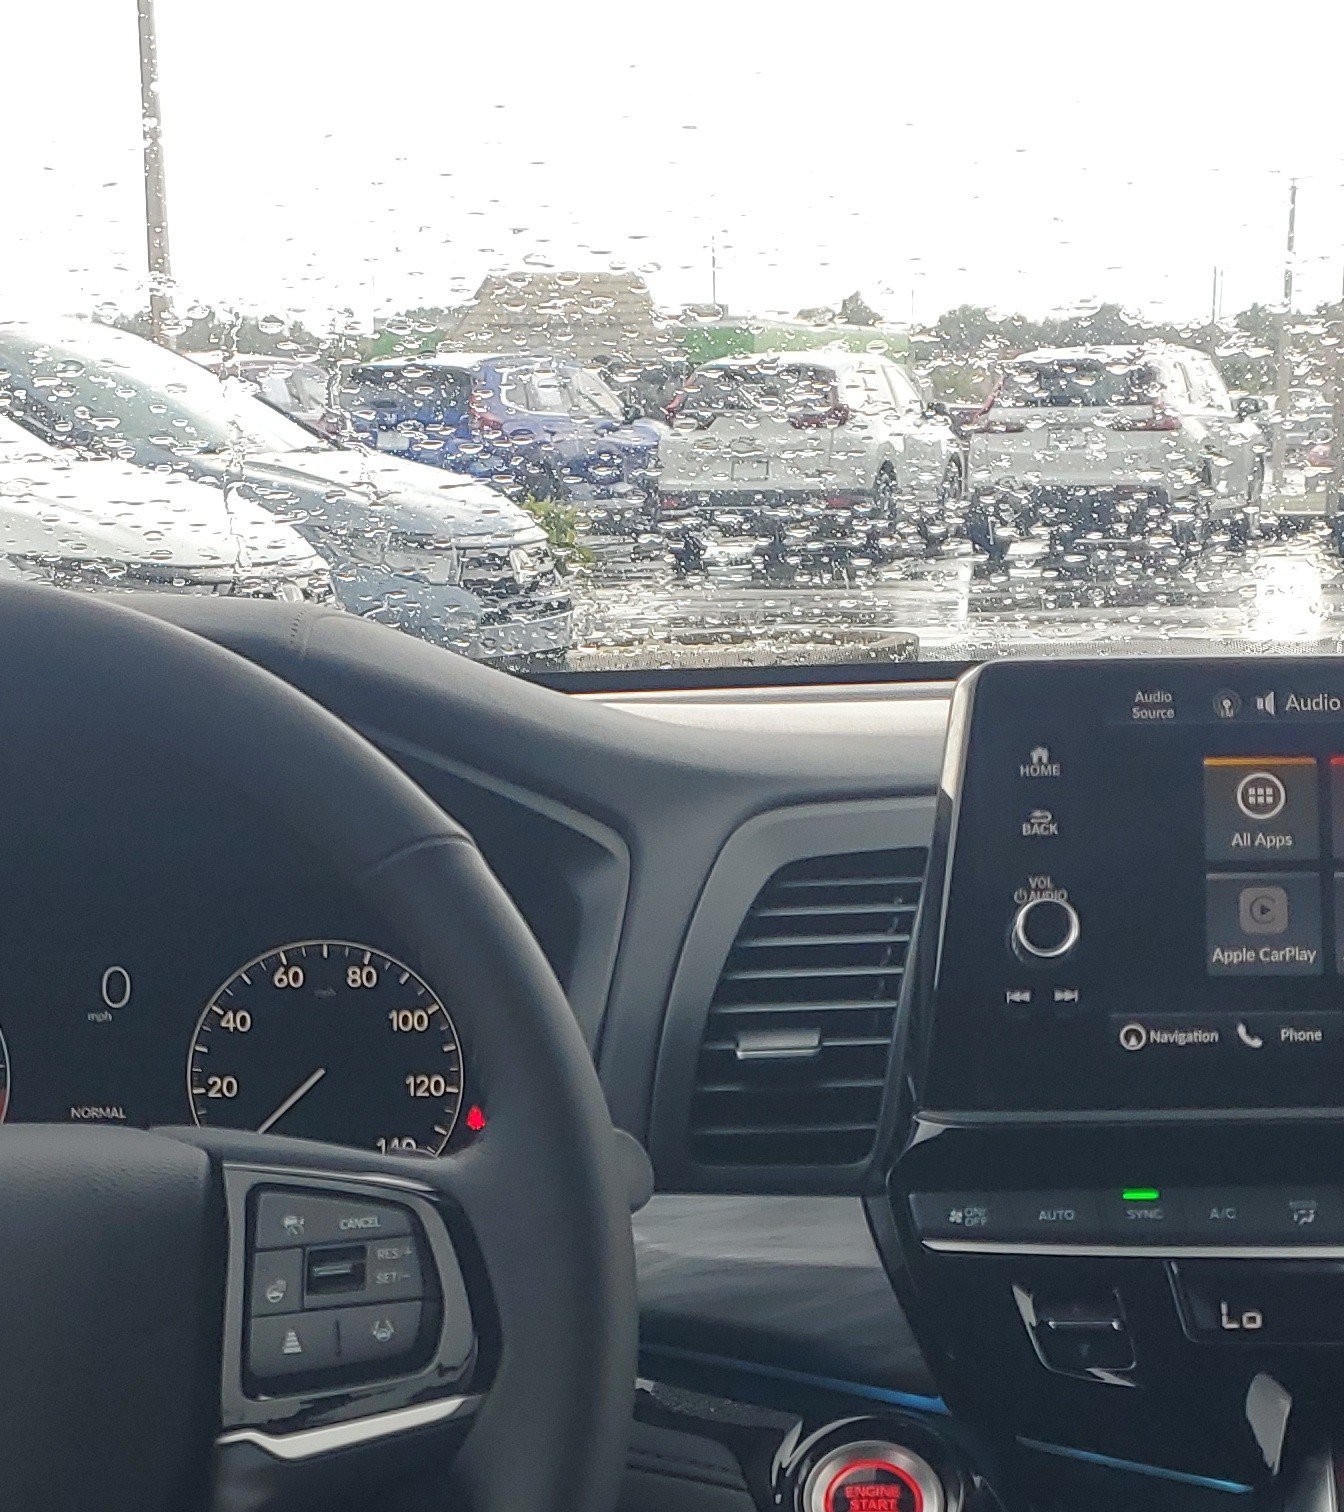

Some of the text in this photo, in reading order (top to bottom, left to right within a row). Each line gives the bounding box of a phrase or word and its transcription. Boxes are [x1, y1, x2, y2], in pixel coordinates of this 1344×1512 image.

[1135, 690, 1173, 704] Audio
[1285, 693, 1341, 711] Audio
[1132, 705, 1175, 719] Source
[1020, 764, 1061, 777] HOME
[1022, 822, 1058, 836] BACK
[1231, 832, 1293, 850] All Apps
[1028, 876, 1054, 889] VOL
[1212, 946, 1317, 965] Apple CarPlay
[273, 965, 305, 989] 60
[346, 965, 378, 989] 80
[102, 965, 132, 1009] 0
[87, 1011, 113, 1024] mph
[219, 1009, 252, 1032] 40
[388, 1009, 429, 1032] 100
[1149, 1028, 1219, 1045] Navigation
[1280, 1027, 1323, 1042] Phone
[206, 1075, 238, 1098] 20
[405, 1074, 446, 1097] 120
[69, 1106, 127, 1120] NORMAL
[1038, 1209, 1076, 1221] AUTO
[1125, 1209, 1164, 1220] SYNC
[1208, 1208, 1237, 1220] A/C
[339, 1214, 382, 1231] CANCEL
[845, 1485, 900, 1499] ENGINE
[850, 1499, 898, 1511] START
